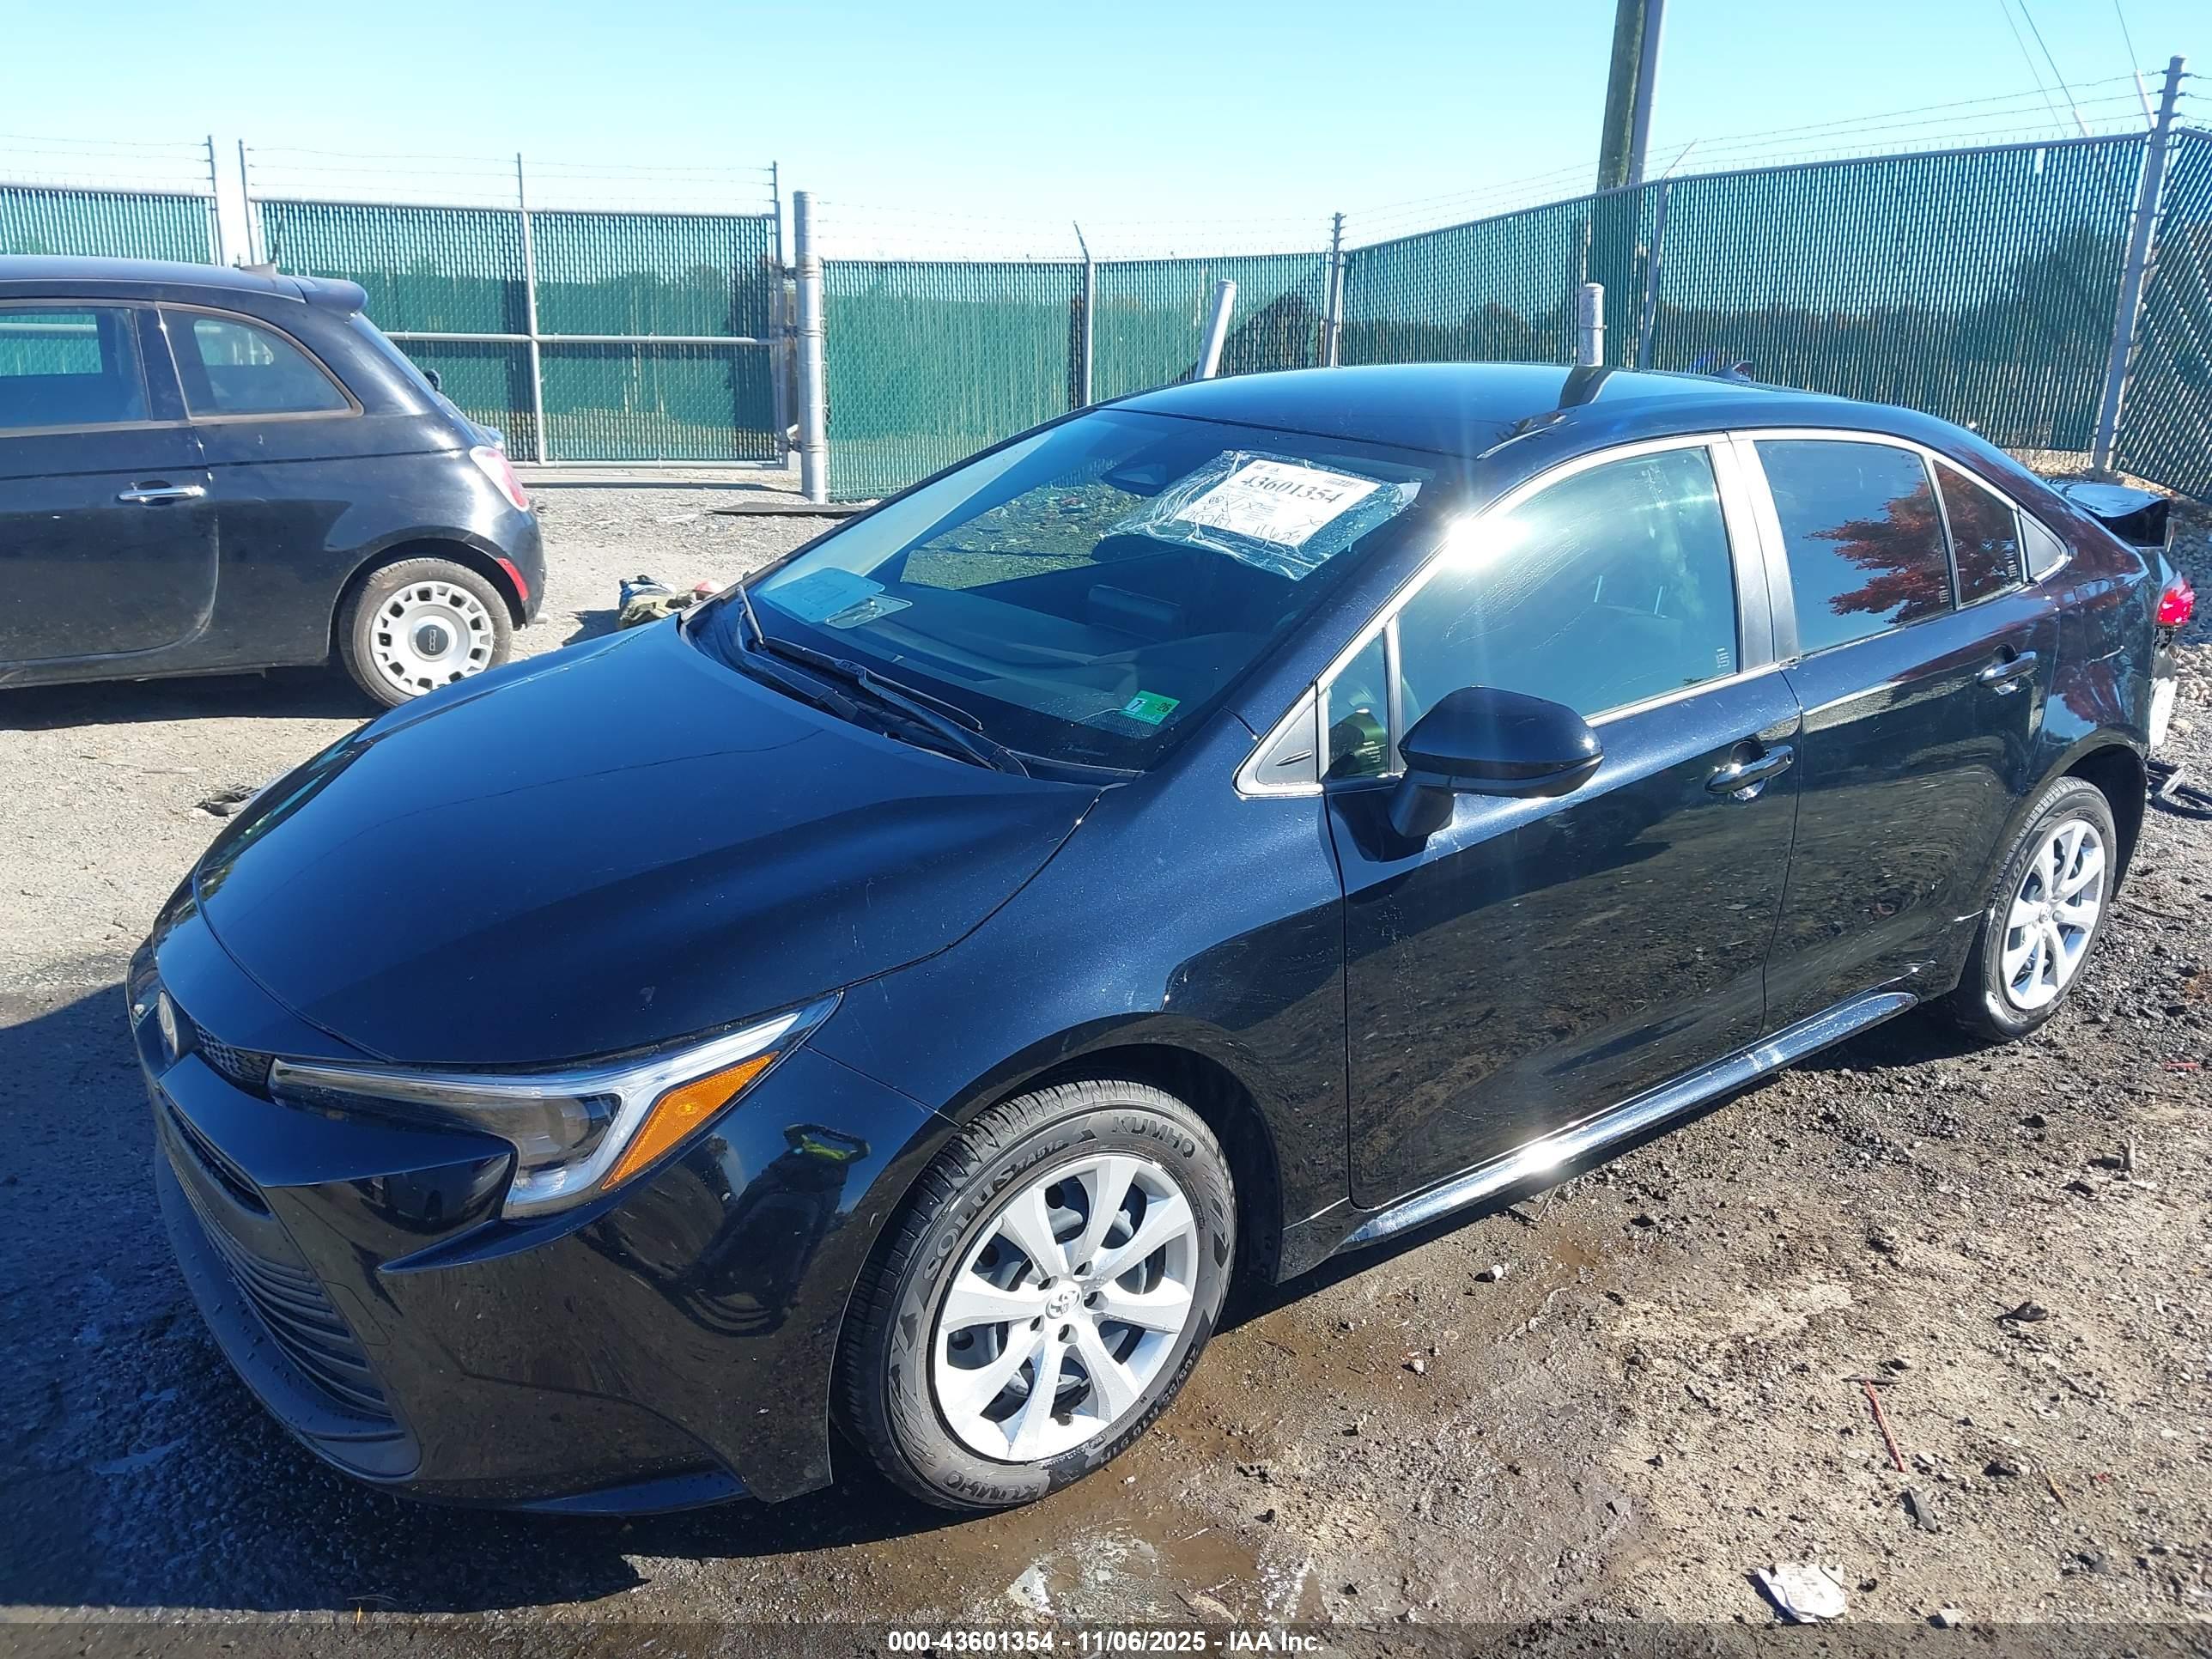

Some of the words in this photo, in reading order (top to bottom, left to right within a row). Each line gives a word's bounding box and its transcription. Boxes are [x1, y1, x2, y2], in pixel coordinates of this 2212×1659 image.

[1241, 475, 1345, 504] 43601354
[1156, 702, 1172, 713] 26
[1110, 1115, 1196, 1159] KUMHO
[923, 1164, 1018, 1281] SOLUS
[942, 1470, 1040, 1501] KUMHO
